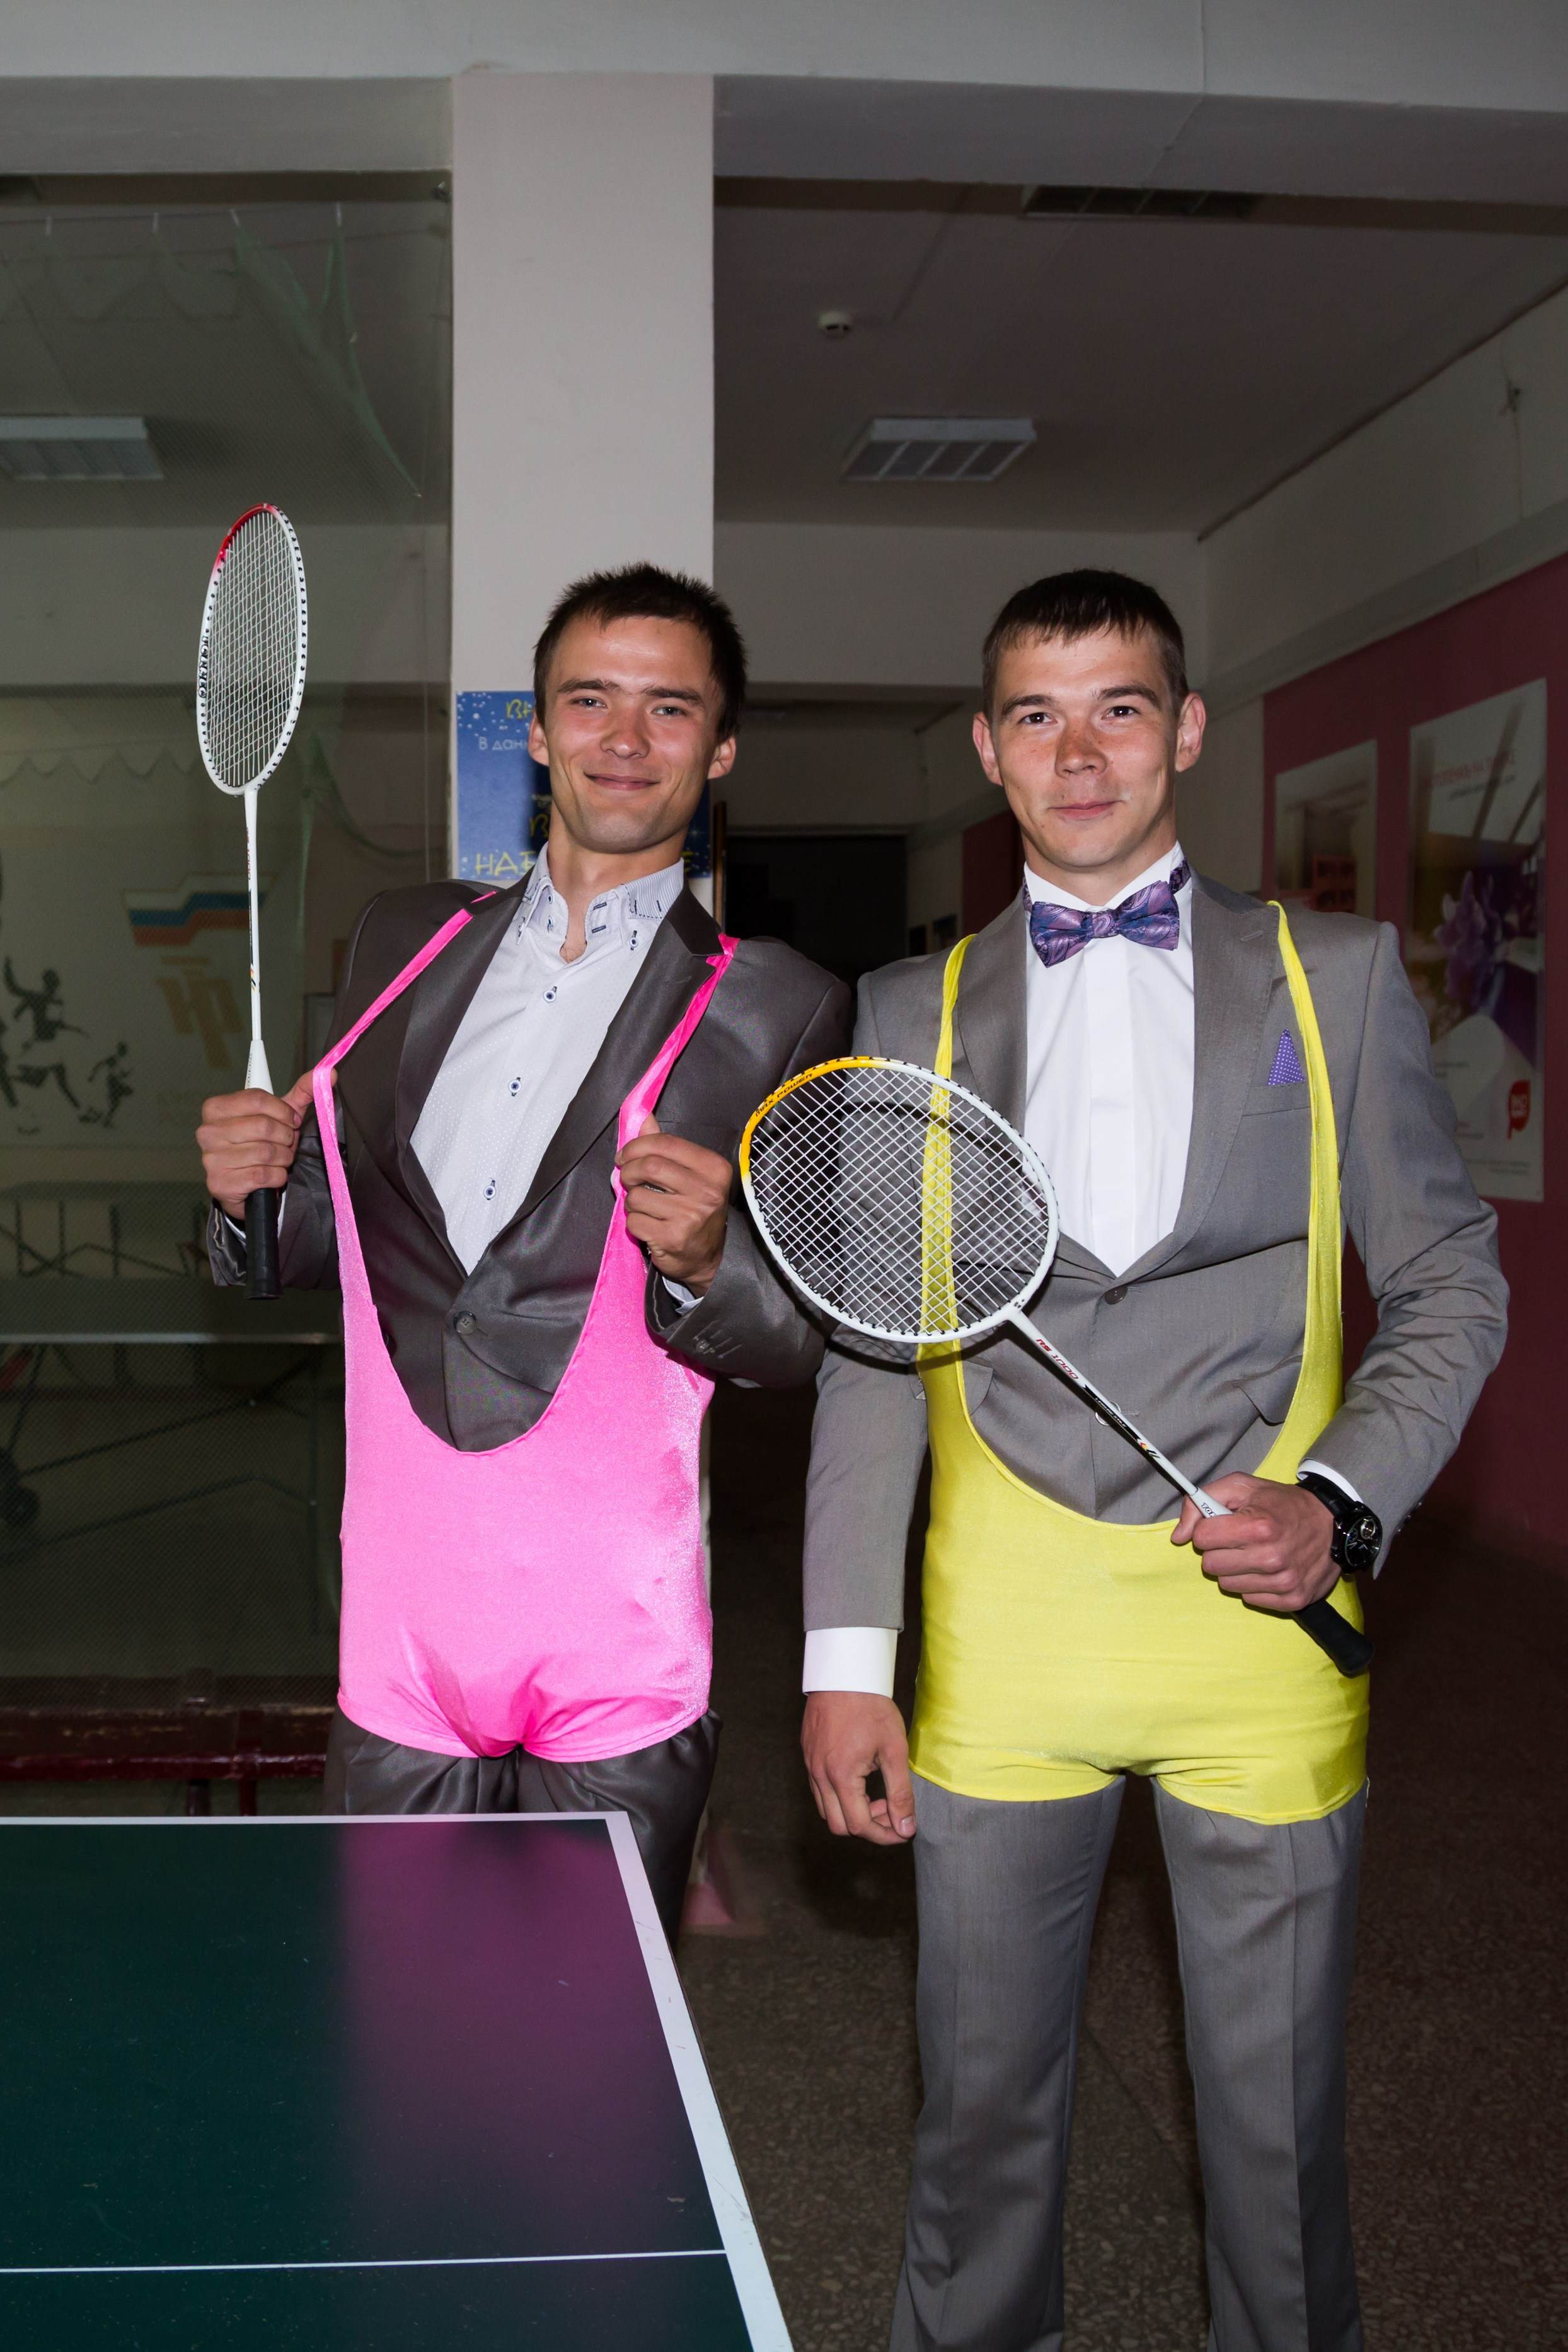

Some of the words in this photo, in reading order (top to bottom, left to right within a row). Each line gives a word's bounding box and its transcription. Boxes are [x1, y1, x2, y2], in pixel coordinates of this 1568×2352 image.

[478, 737, 488, 751] В
[756, 1098, 773, 1116] MAX
[778, 1074, 812, 1097] POWER
[1036, 1339, 1052, 1351] RS
[1051, 1355, 1078, 1379] 1000
